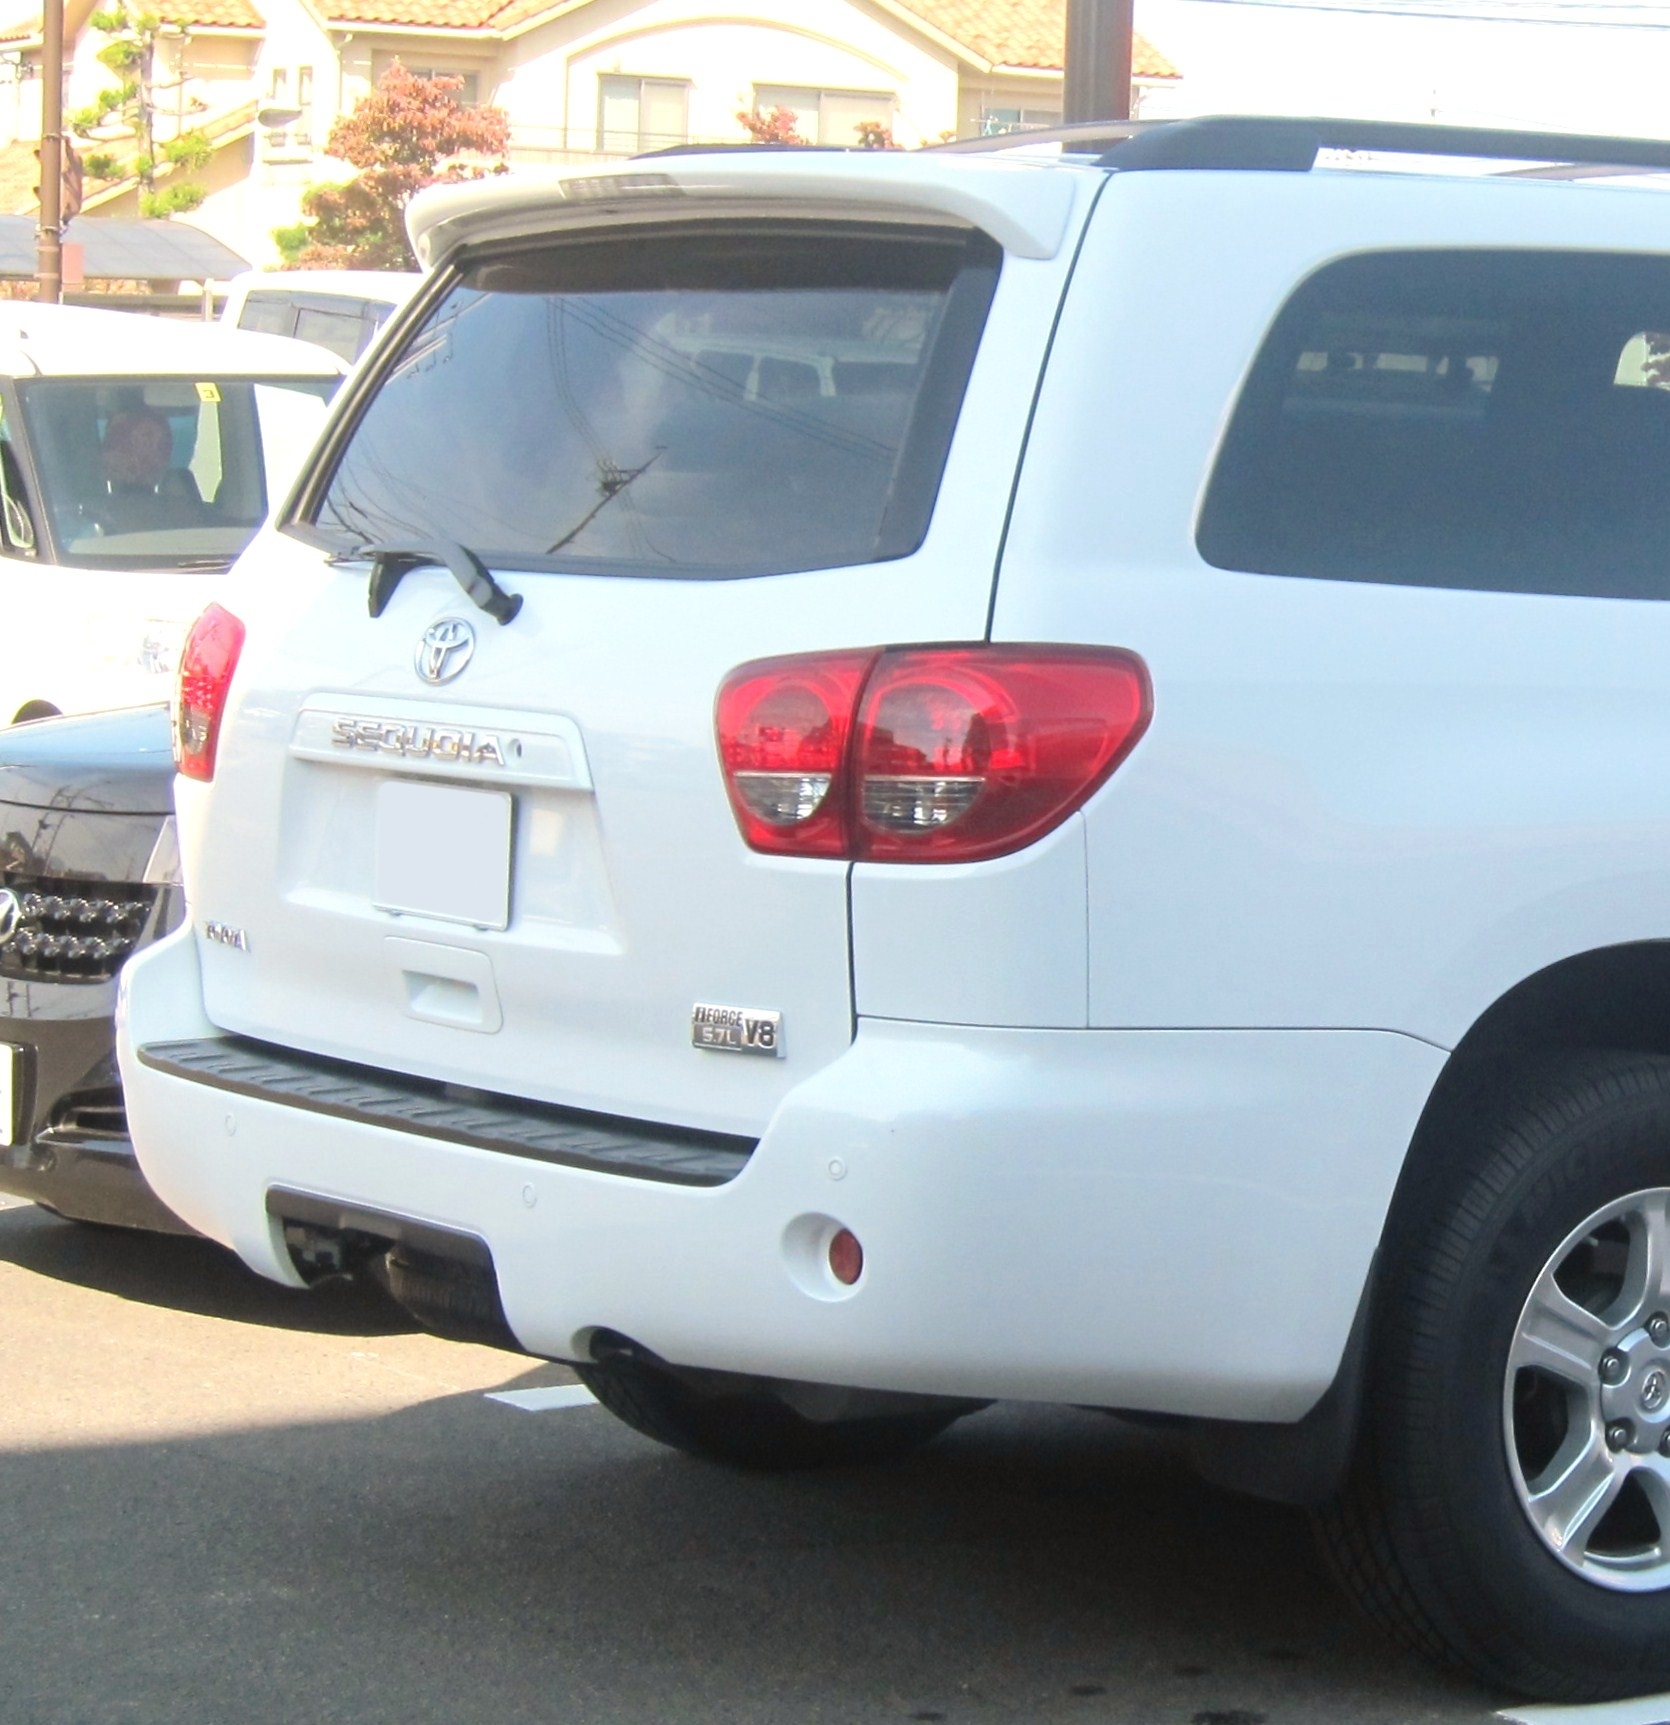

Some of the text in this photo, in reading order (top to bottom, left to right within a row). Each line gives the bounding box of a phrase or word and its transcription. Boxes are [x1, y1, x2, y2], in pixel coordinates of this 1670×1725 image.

[332, 717, 505, 767] SEQUOIA
[702, 1018, 777, 1049] 5.7L V8
